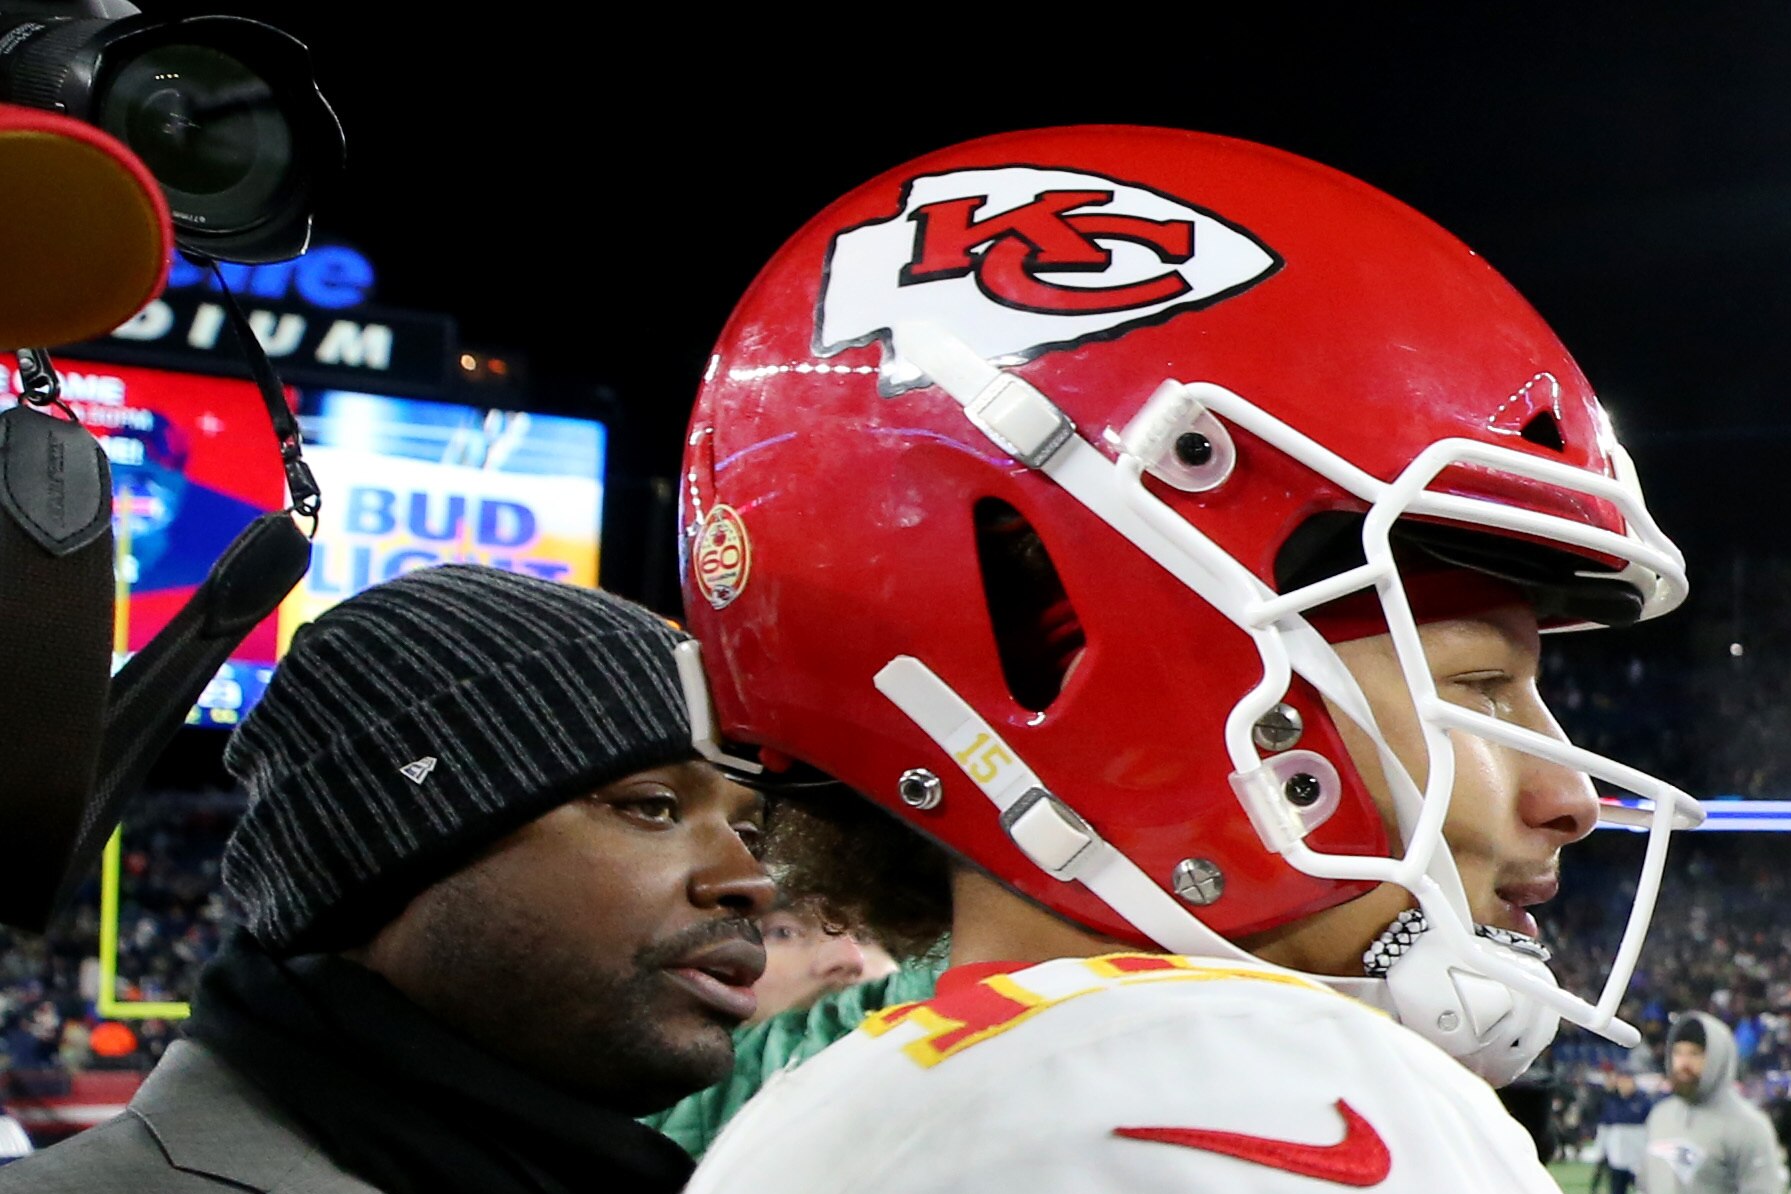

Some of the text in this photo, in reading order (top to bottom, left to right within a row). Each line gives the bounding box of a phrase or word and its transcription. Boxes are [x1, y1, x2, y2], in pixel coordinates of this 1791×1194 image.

[899, 190, 1196, 316] KC
[346, 487, 538, 548] BUD
[701, 544, 740, 575] 60
[955, 732, 1013, 784] 15
